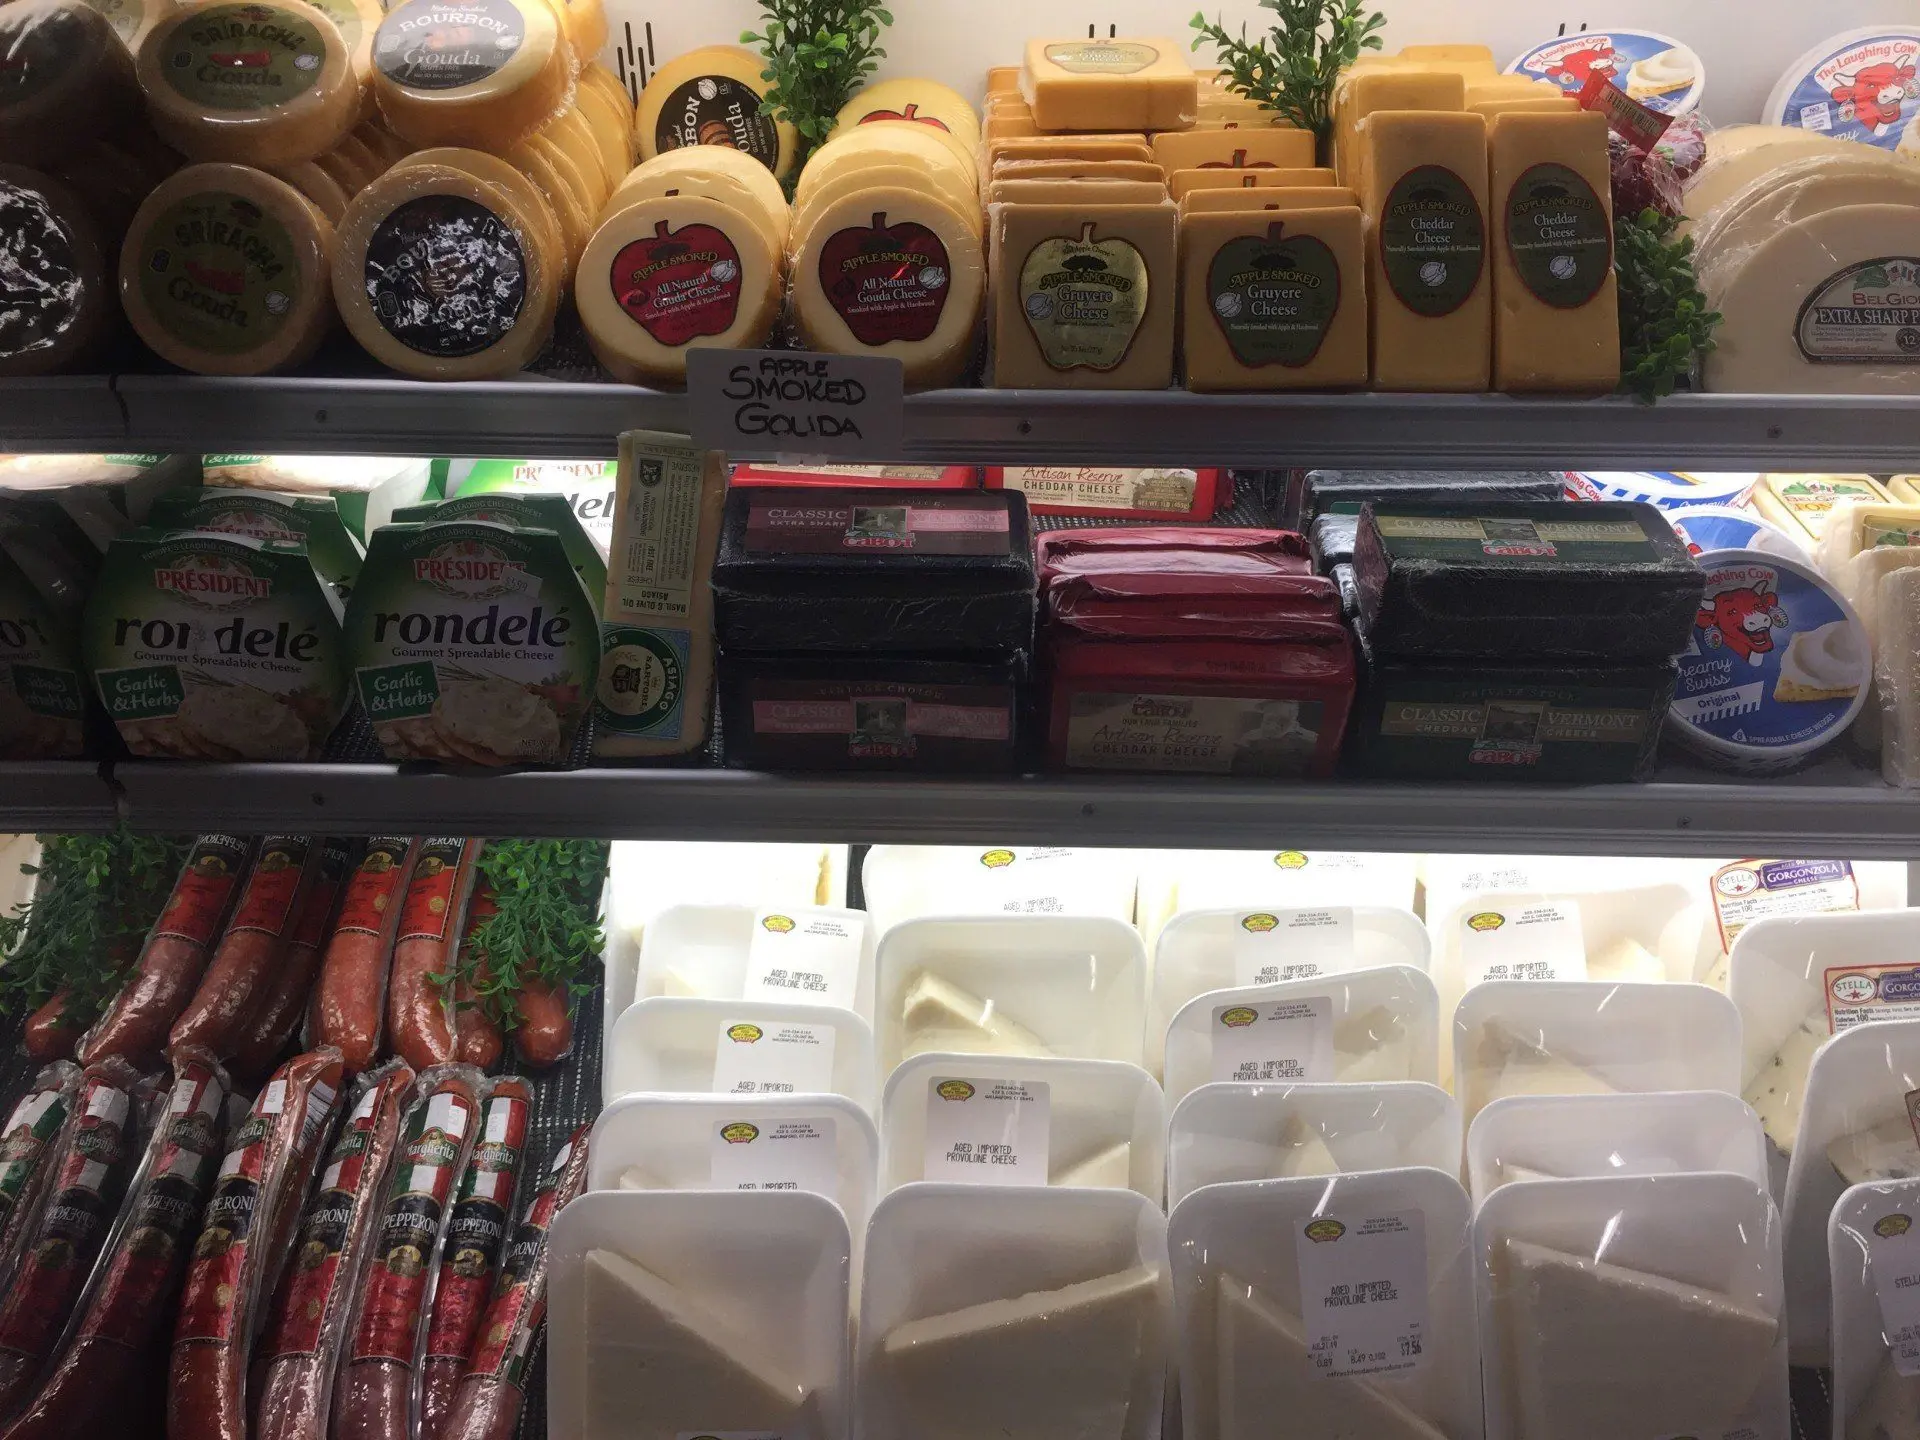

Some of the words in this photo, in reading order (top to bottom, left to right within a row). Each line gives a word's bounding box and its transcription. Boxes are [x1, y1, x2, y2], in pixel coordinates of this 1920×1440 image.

[400, 12, 508, 33] BOURBON
[191, 22, 306, 52] SRIRACHA
[404, 42, 481, 77] Gouda
[1527, 56, 1542, 68] The
[1542, 41, 1585, 60] Laughing
[1586, 37, 1608, 46] Cow
[1816, 65, 1836, 80] The
[1837, 46, 1891, 70] Laughing
[1893, 42, 1917, 54] Cow
[197, 64, 282, 86] Gouda
[726, 102, 750, 152] ouda
[1392, 201, 1426, 217] APPLE
[1428, 201, 1472, 216] SMOKED
[1514, 198, 1548, 216] APPLE
[1549, 196, 1593, 210] SMOKED
[1411, 216, 1455, 230] Cheddar
[1534, 213, 1578, 226] Cheddar
[1415, 231, 1451, 243] Cheese
[1540, 227, 1576, 239] Cheese
[176, 221, 283, 281] SRIRACHA
[670, 252, 718, 265] SMOKED
[841, 252, 880, 272] APPLE
[881, 252, 929, 266] SMOKED
[657, 284, 670, 296] All
[672, 272, 708, 290] Natural
[862, 277, 876, 290] All
[879, 276, 916, 287] Natural
[1038, 272, 1082, 290] APPLE
[1083, 272, 1133, 292] SMOKED
[1229, 270, 1270, 288] APPLE
[1271, 270, 1321, 288] SMOKED
[168, 276, 248, 327] Gouda
[653, 294, 687, 309] Gouda
[688, 284, 722, 299] Cheese
[857, 291, 890, 304] Gouda
[893, 288, 927, 299] Cheese
[1058, 285, 1114, 306] Gruyere
[1248, 284, 1303, 303] Gruyere
[1061, 302, 1109, 319] Cheese
[1251, 301, 1298, 316] Cheese
[1819, 309, 1863, 324] EXTRA
[1864, 309, 1909, 324] SHARP
[1903, 336, 1916, 345] 12
[759, 357, 829, 377] APPLE
[722, 365, 866, 405] SMOKED
[734, 402, 863, 440] GOUDA
[1023, 468, 1071, 481] Artisan
[1077, 468, 1124, 483] Reserve
[1023, 481, 1073, 491] CHEDDAR
[1079, 484, 1120, 495] CHEESE
[1585, 484, 1602, 501] Cow
[768, 509, 848, 520] CLASSIC
[1393, 519, 1477, 530] CLASSIC
[1540, 522, 1633, 533] VERMONT
[156, 568, 271, 598] PRÉSIDENT
[1706, 569, 1745, 586] ughing
[1748, 567, 1774, 581] Cow
[373, 606, 572, 647] rondelé
[392, 647, 444, 658] Gourmet
[448, 647, 511, 659] Spreadable
[514, 649, 554, 660] Cheese
[134, 650, 188, 664] Gourmet
[192, 655, 257, 670] Spreadable
[261, 662, 303, 674] Cheese
[115, 675, 168, 693] Garlic
[373, 671, 424, 693] Garlic
[659, 657, 677, 710] ASIAGO
[1685, 675, 1731, 691] Swiss
[1697, 692, 1740, 709] Original
[770, 704, 848, 718] CLASSIC
[1400, 707, 1481, 724] CLASSIC
[1547, 711, 1639, 729] VERMONT
[1091, 725, 1155, 743] Artisan
[1163, 727, 1222, 745] Reserve
[1415, 724, 1478, 734] CHEDDAR
[1546, 728, 1596, 738] CHEESE
[1749, 734, 1790, 743] SPREADABLE
[1791, 726, 1814, 741] CHEESE
[1813, 712, 1837, 732] WEDGES
[1092, 743, 1157, 755] CHEDDAR
[1164, 745, 1218, 756] CHEESE
[1719, 875, 1754, 886] STELLA
[1767, 864, 1839, 883] GORGONZOLA
[1793, 876, 1819, 884] CHEESE
[1721, 901, 1742, 909] Nutrition
[1741, 905, 1752, 913] 100
[771, 969, 787, 978] AGED
[792, 971, 823, 982] IMPORTED
[1261, 966, 1278, 975] AGED
[1284, 964, 1317, 974] IMPORTED
[1490, 965, 1508, 974] AGED
[1513, 962, 1548, 972] IMPORTED
[1528, 971, 1555, 980] CHEESE
[763, 976, 800, 989] PROVOLONE
[804, 982, 828, 992] CHEESE
[1835, 983, 1872, 992] STELLA
[1857, 1014, 1868, 1022] 100
[1240, 1062, 1258, 1071] AGED
[1263, 1059, 1297, 1069] IMPORTED
[1233, 1071, 1273, 1081] PROVOLONE
[1278, 1068, 1304, 1078] CHEESE
[738, 1081, 755, 1090] AGED
[760, 1083, 794, 1093] IMPORTED
[954, 1143, 972, 1152] AGED
[977, 1144, 1012, 1154] IMPORTED
[946, 1152, 987, 1163] PROVOLONE
[991, 1154, 1017, 1165] CHEESE
[762, 1182, 798, 1190] IMPORTED
[1331, 1285, 1349, 1296] AGED
[1355, 1281, 1391, 1294] IMPORTED
[1324, 1295, 1366, 1308] PROVOLONE
[1371, 1290, 1398, 1302] CHEESE
